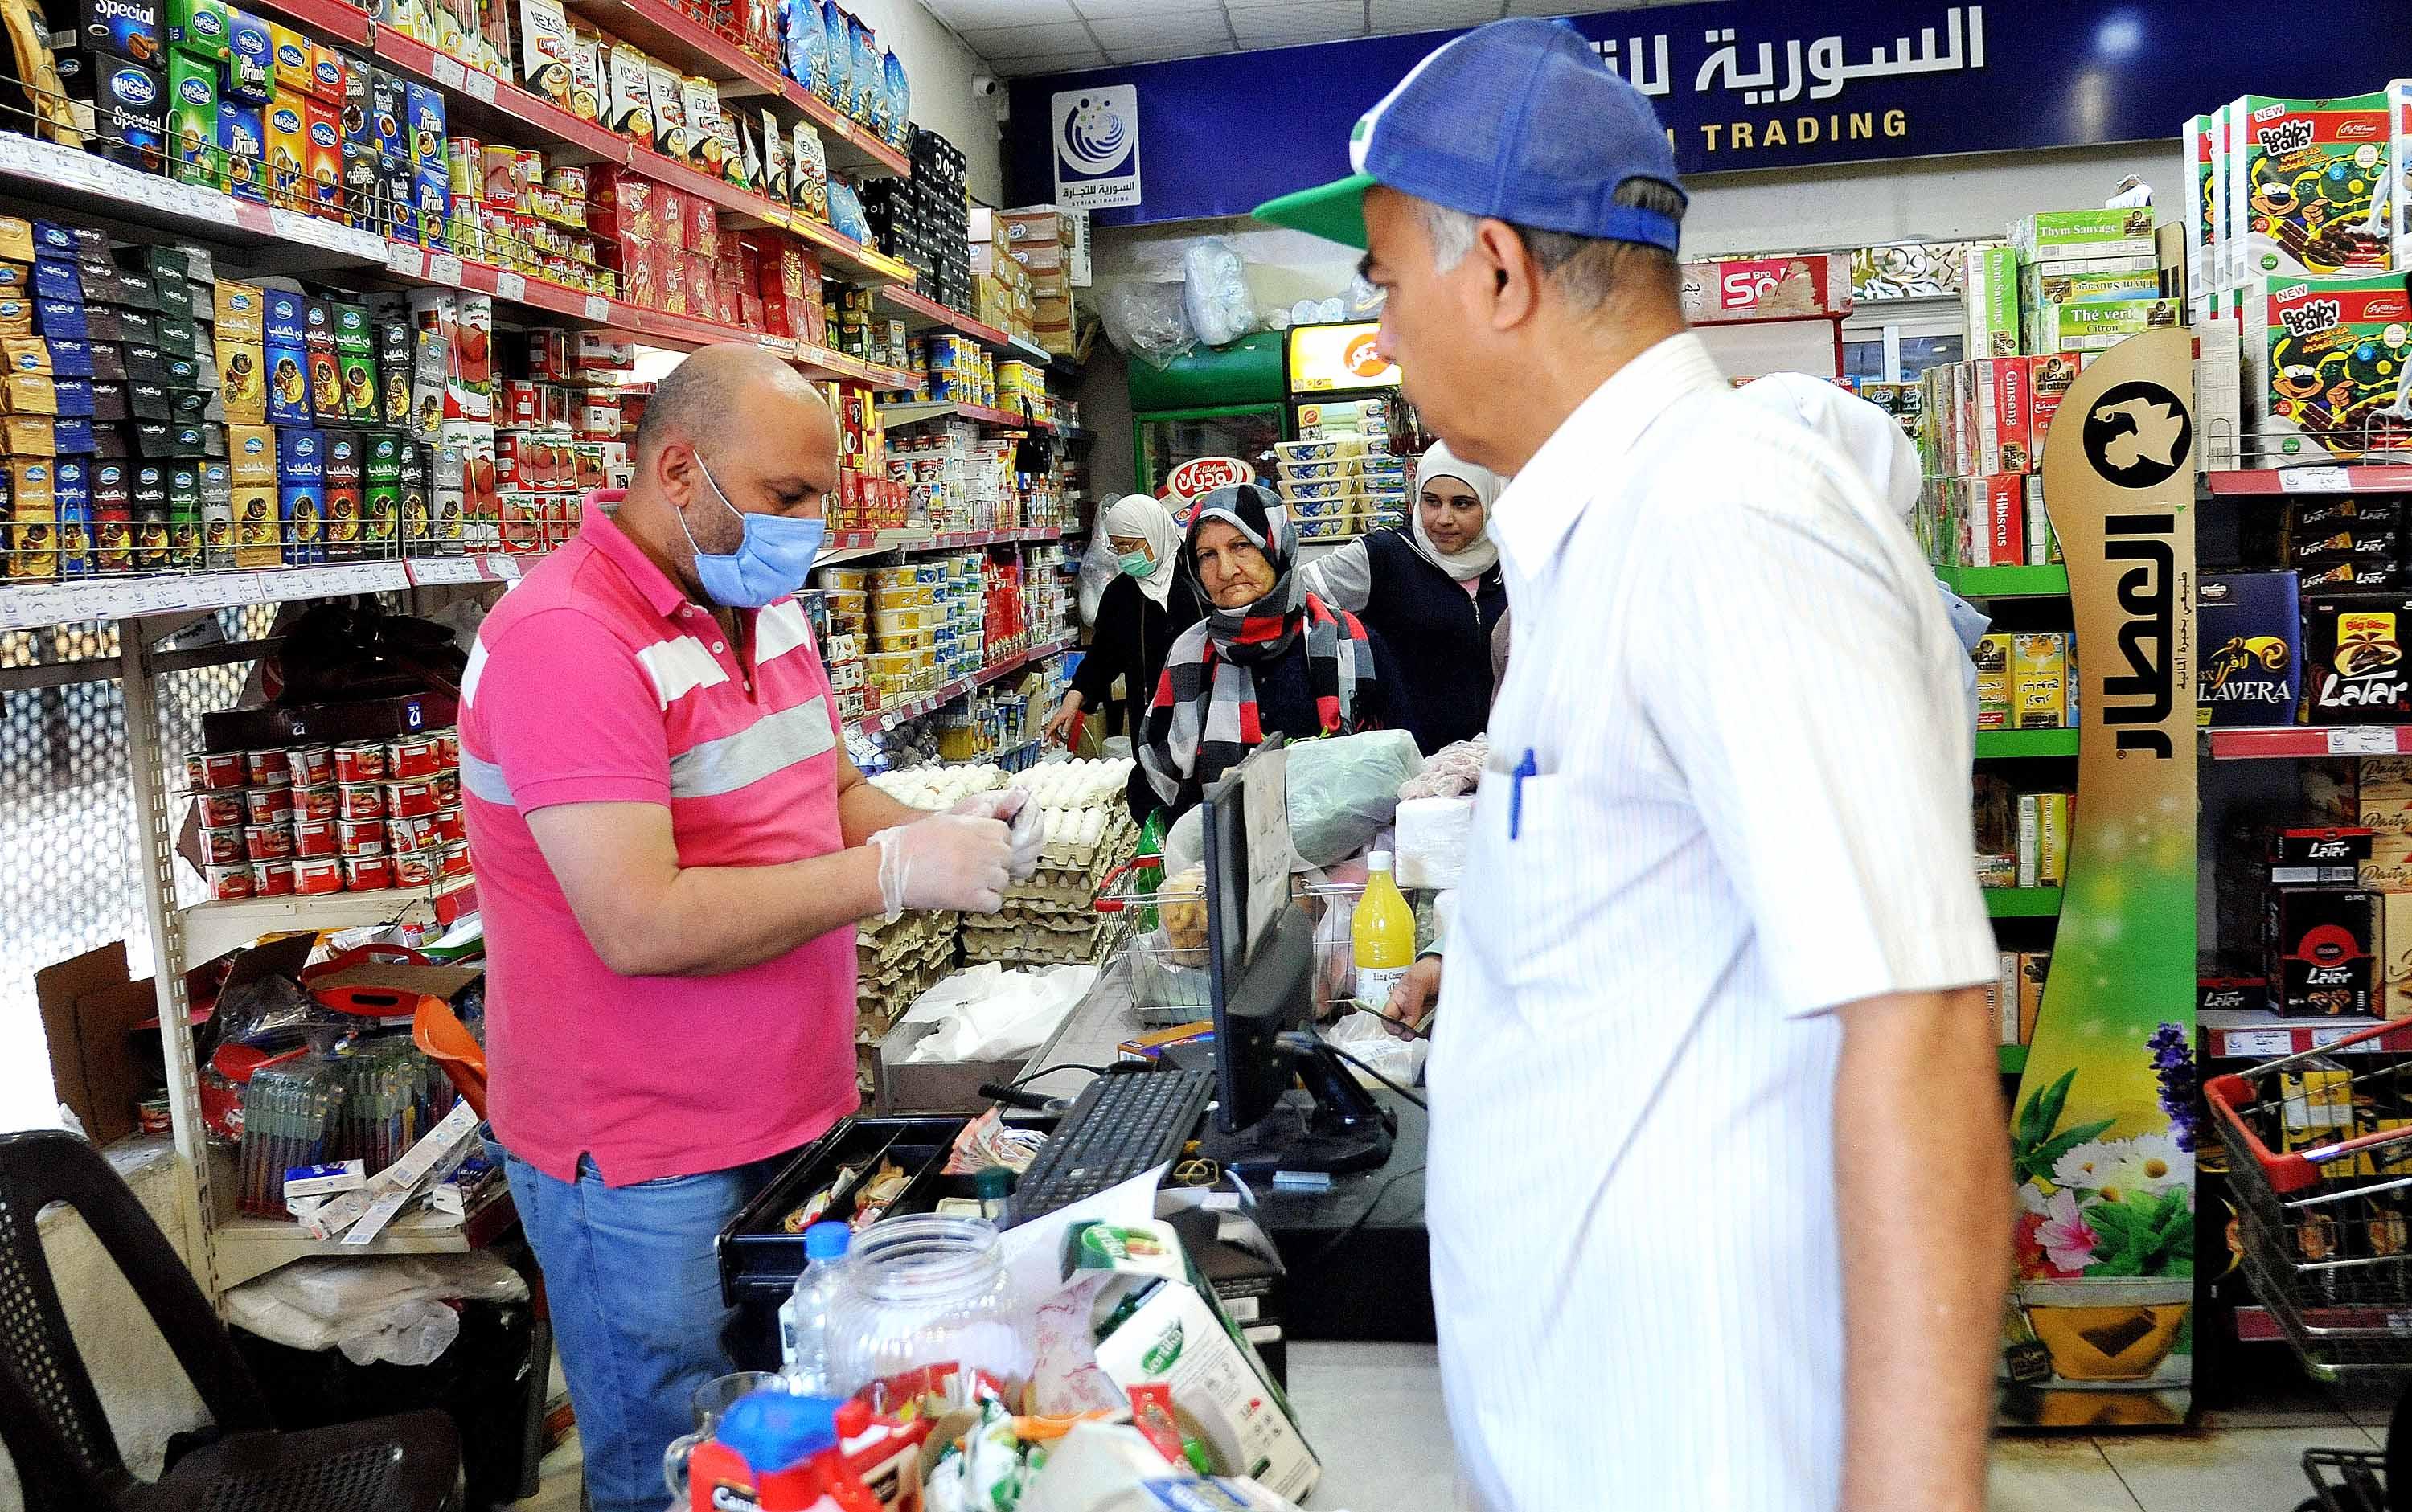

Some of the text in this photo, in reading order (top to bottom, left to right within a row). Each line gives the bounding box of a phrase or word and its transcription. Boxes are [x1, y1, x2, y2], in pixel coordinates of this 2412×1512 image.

[95, 0, 154, 26] Special
[1695, 5, 1984, 104] السورية
[240, 64, 265, 81] Drink
[113, 105, 161, 135] Special
[2256, 105, 2284, 121] NEW
[1700, 109, 1907, 152] TRADING
[2259, 121, 2312, 145] Bobby
[232, 135, 260, 155] Drink
[2269, 135, 2309, 154] Balls
[1062, 182, 1134, 199] السورية للتجارة
[2040, 223, 2118, 240] Thym Sauvage
[1752, 270, 1771, 280] Bro
[2278, 285, 2306, 301] NEW
[2070, 308, 2132, 322] Thé vert
[2281, 302, 2337, 325] Bobby
[2086, 323, 2119, 334] Citron
[2292, 317, 2336, 334] Balls
[2005, 371, 2017, 427] Ginseng
[1996, 492, 2008, 547] Hibiscus
[2177, 571, 2191, 616] طبيعي
[2103, 514, 2175, 759] العطار
[2177, 618, 2190, 654] بخبرة
[2197, 680, 2291, 704] LAVERA
